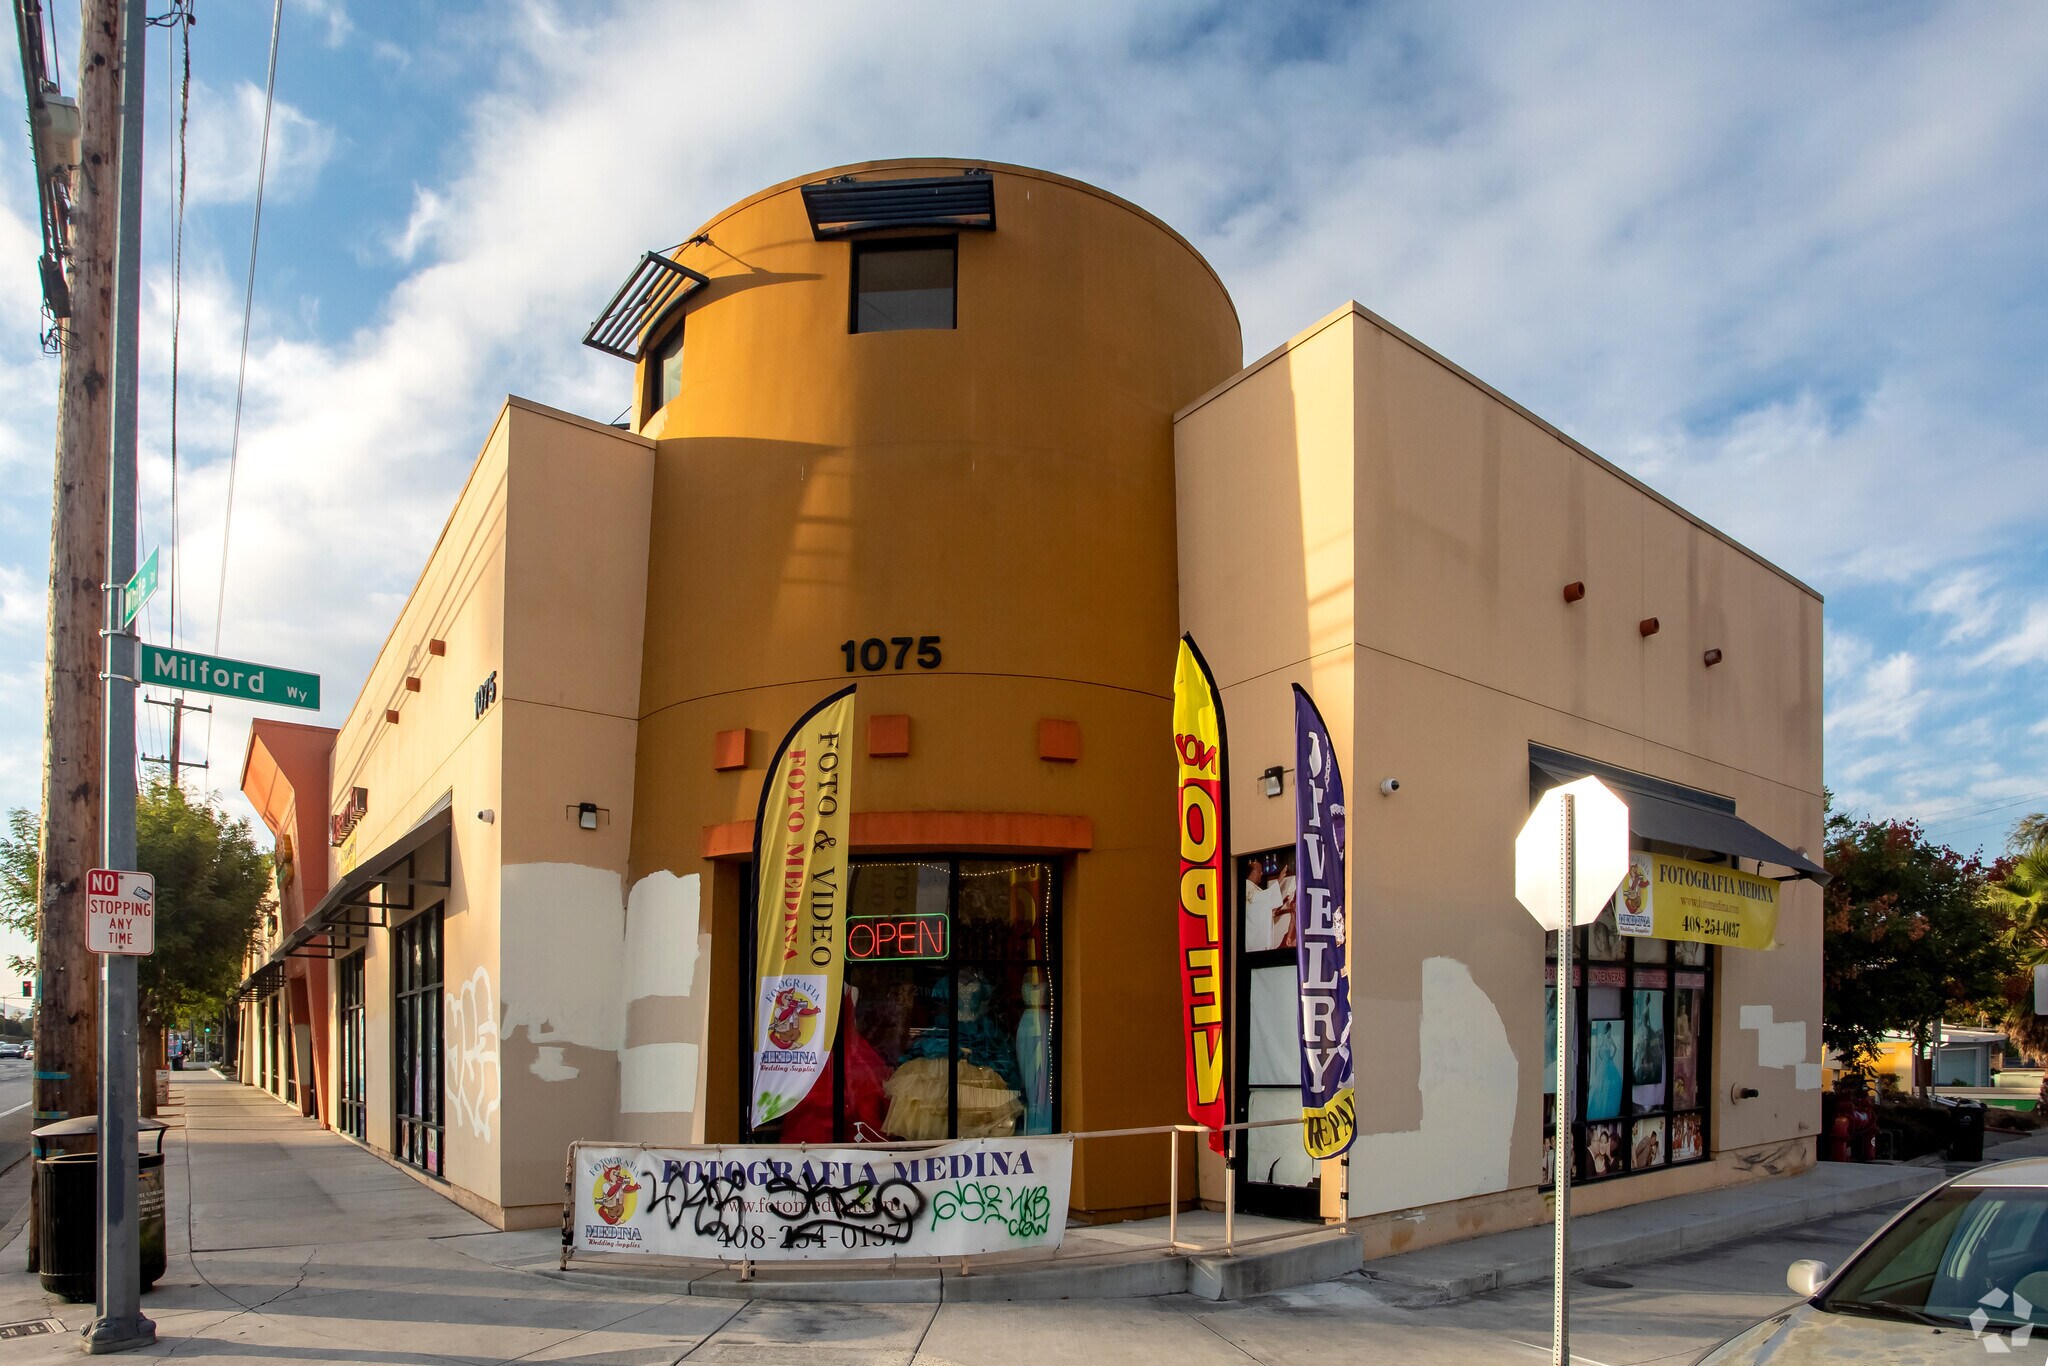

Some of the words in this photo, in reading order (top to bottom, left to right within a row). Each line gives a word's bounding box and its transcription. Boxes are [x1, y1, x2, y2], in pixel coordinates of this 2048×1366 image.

[841, 636, 942, 672] 1075
[154, 652, 265, 694] Milford
[287, 686, 307, 702] Wy
[818, 731, 840, 818] FOTO
[787, 748, 806, 833] FOTO
[811, 829, 837, 855] &
[92, 873, 115, 892] NO
[1659, 864, 1735, 895] FOTOGRAFIA
[1738, 879, 1774, 903] MEDINA
[90, 899, 151, 917] STOPPING
[784, 843, 805, 961] MEDINA
[109, 918, 133, 930] ANY
[811, 867, 838, 967] VIDEO
[1682, 915, 1740, 938] 408-254-0137
[109, 932, 133, 945] TIME
[849, 920, 942, 957] OPEN
[765, 978, 820, 1003] FOOGRAFIA
[589, 1156, 640, 1178] FOTOGRAFIA
[660, 1158, 880, 1187] FOTOGRAFIA
[893, 1149, 1034, 1185] MEDINA
[585, 1225, 642, 1241] MEDINA
[588, 1238, 615, 1248] Wedding
[615, 1240, 640, 1249] Supplies
